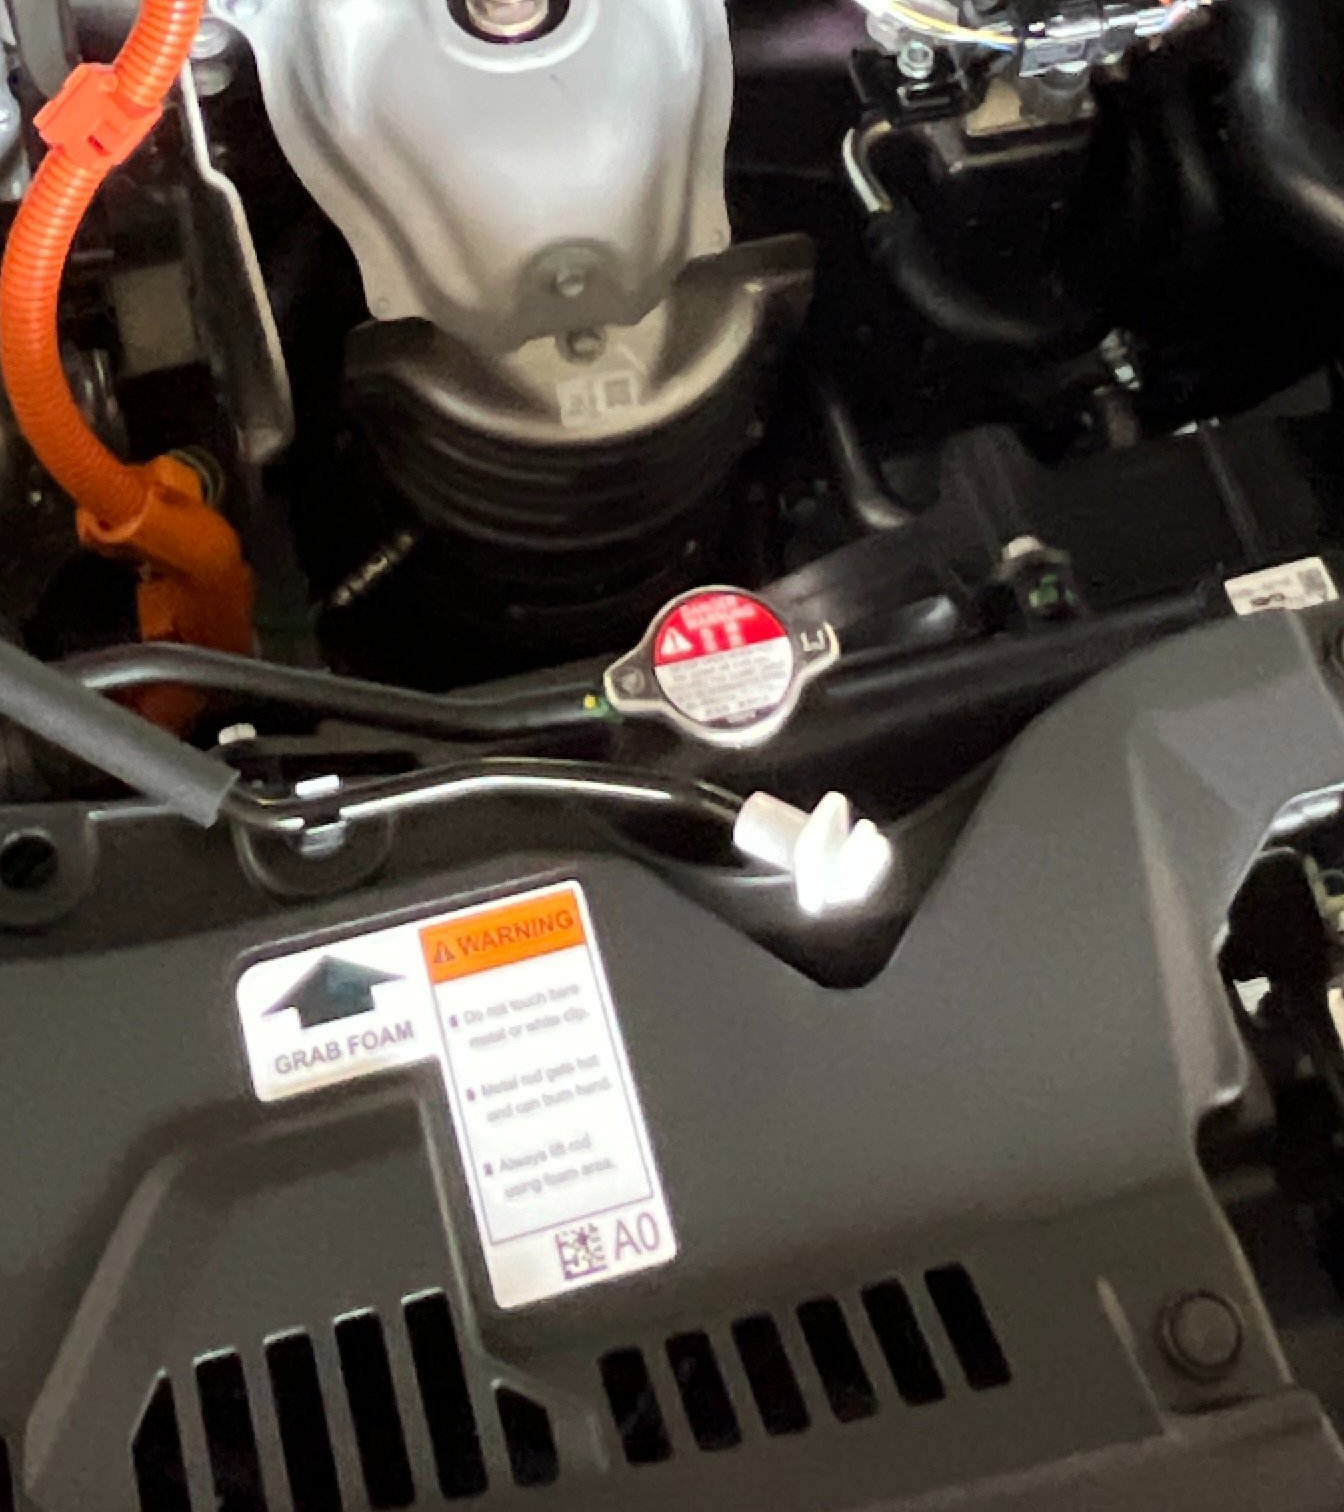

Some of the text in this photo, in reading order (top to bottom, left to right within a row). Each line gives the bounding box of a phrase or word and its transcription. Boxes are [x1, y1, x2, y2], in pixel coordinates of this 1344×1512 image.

[457, 908, 575, 958] WARNING
[274, 1019, 415, 1075] GRAB FOAM
